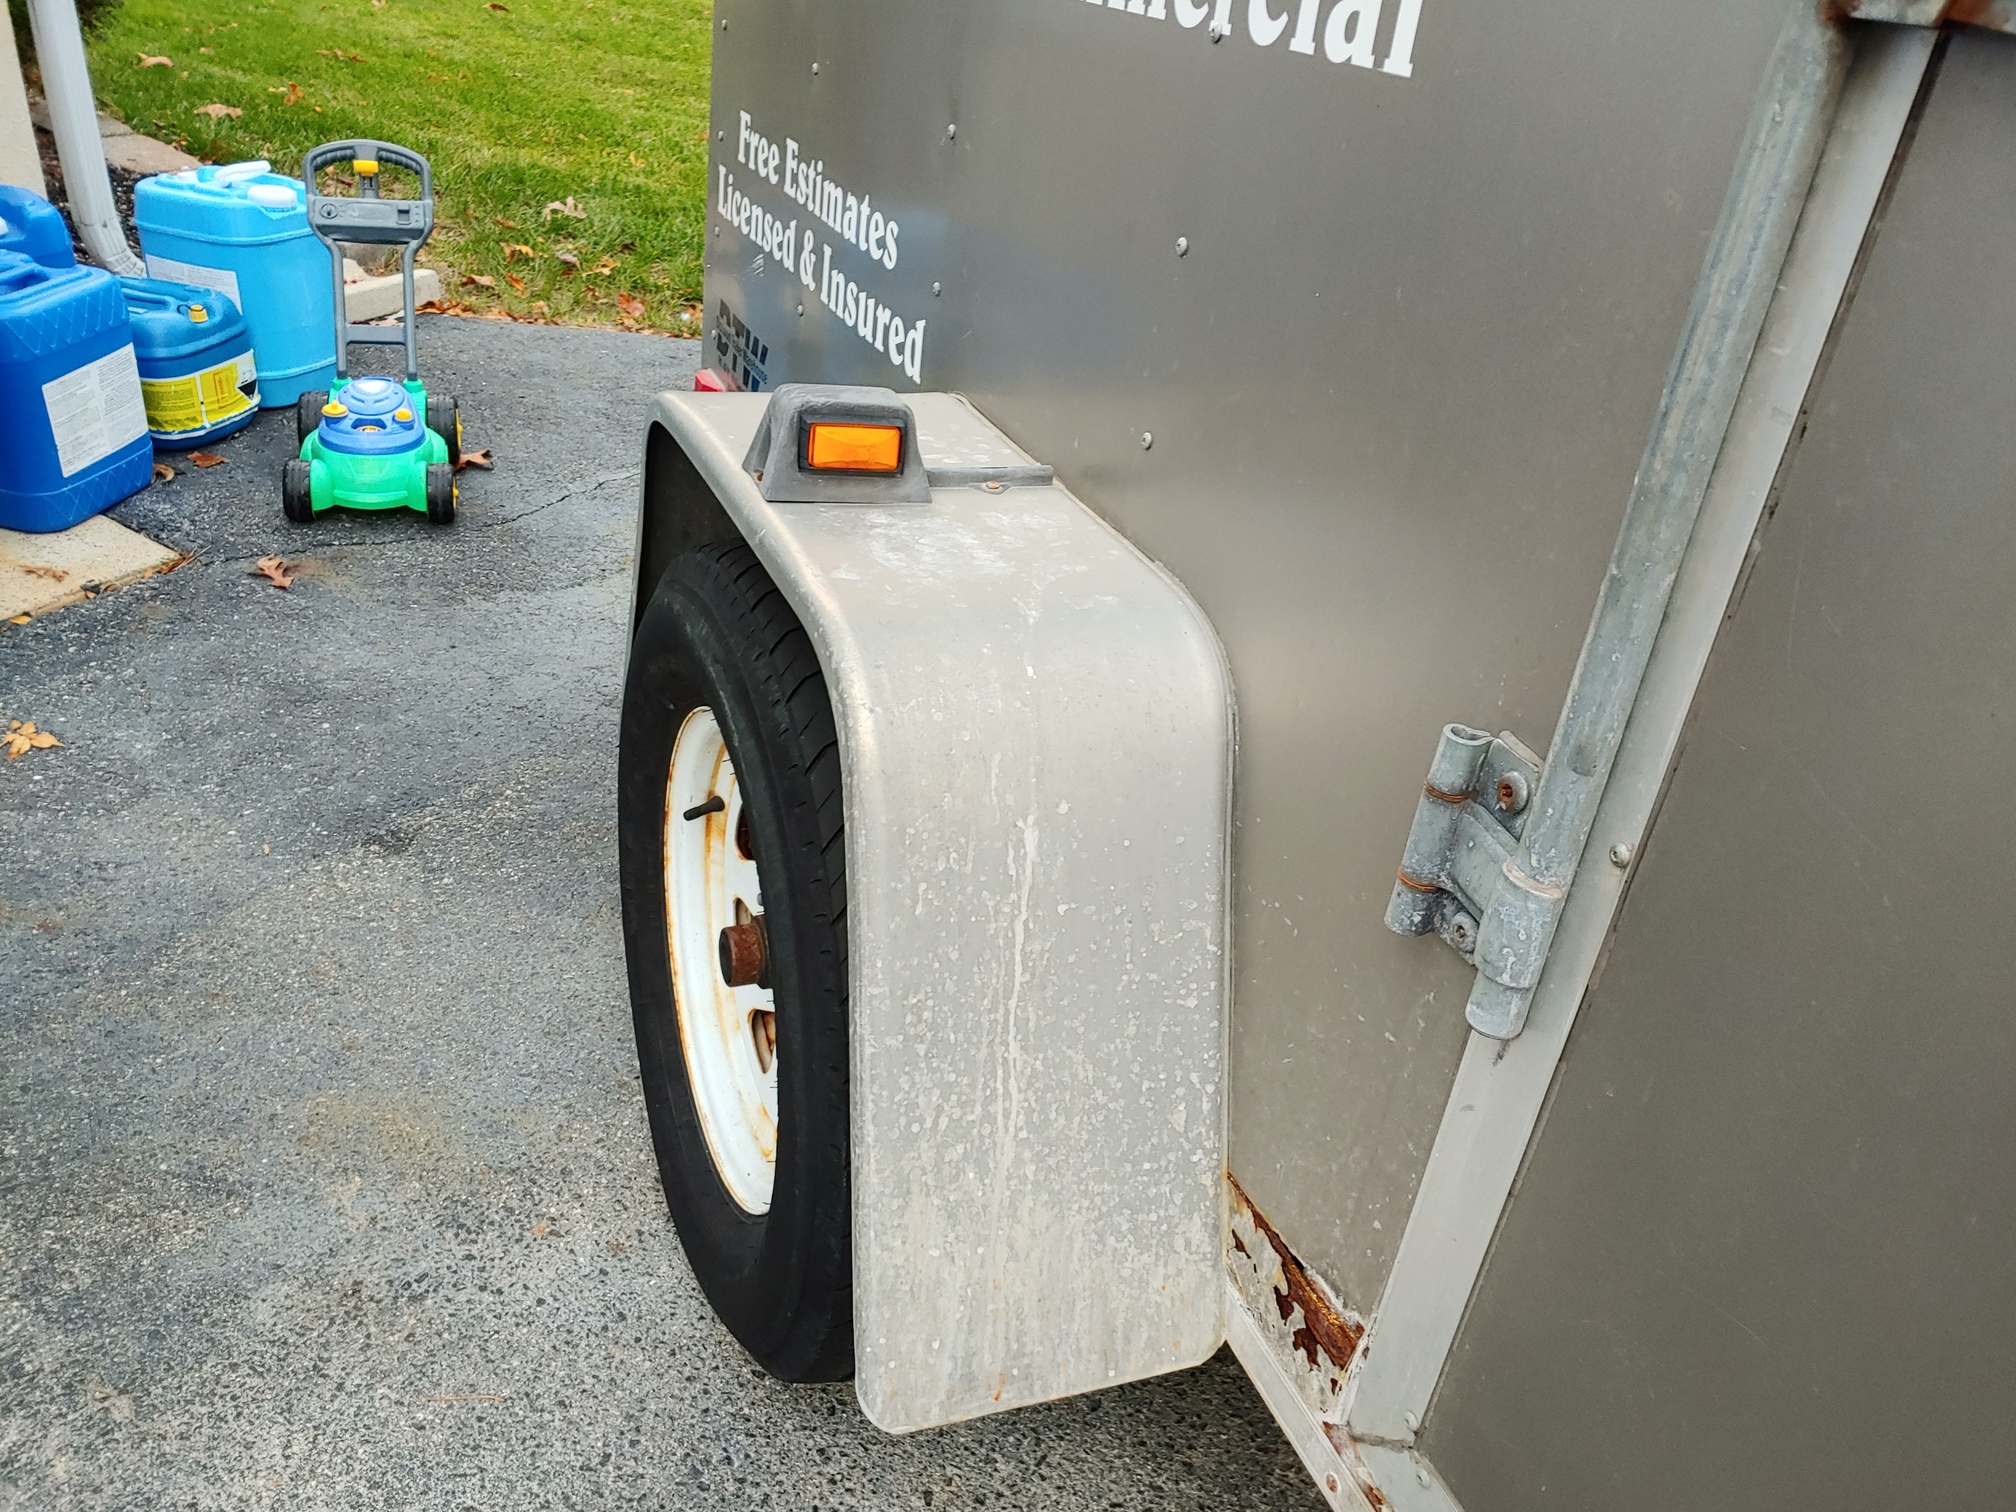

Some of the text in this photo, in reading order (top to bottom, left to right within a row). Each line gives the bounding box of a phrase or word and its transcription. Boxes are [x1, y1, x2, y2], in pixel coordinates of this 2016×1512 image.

[717, 164, 798, 273] Licensed
[799, 228, 817, 292] &
[820, 243, 927, 386] Insured
[737, 110, 900, 271] Free Estimates
